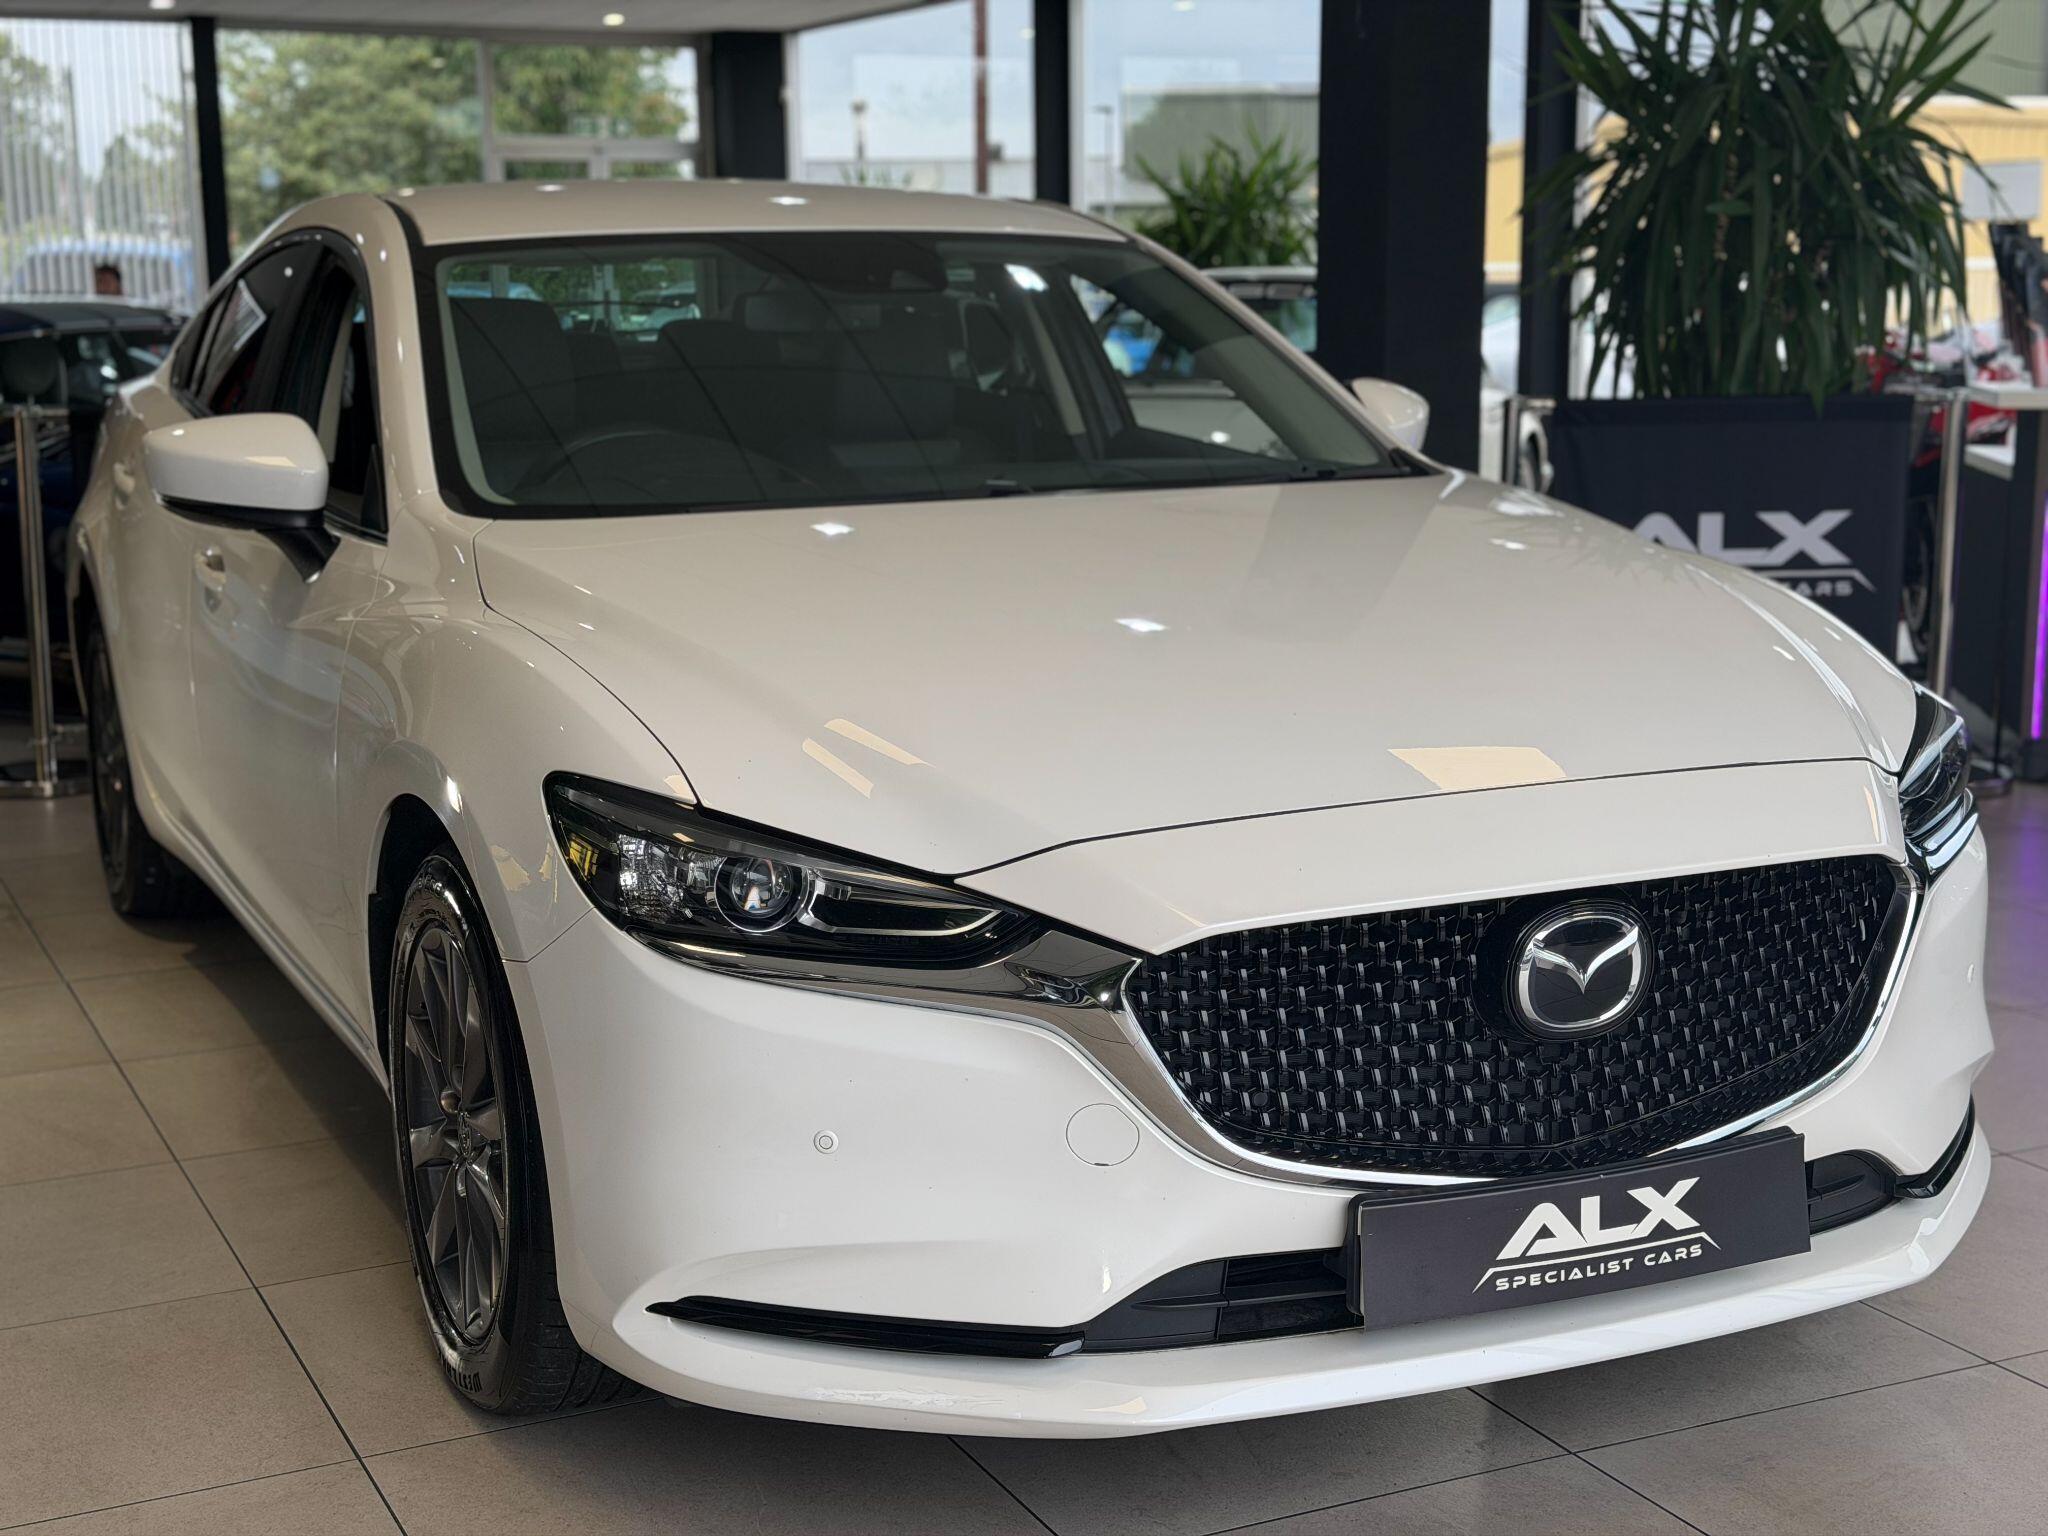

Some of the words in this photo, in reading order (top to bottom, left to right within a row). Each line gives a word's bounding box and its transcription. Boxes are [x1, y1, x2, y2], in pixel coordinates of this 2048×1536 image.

[1784, 580, 1853, 598] ARS
[1496, 1177, 1701, 1261] ALX
[1496, 1257, 1635, 1291] SPECIALIST
[1643, 1243, 1703, 1267] CARS
